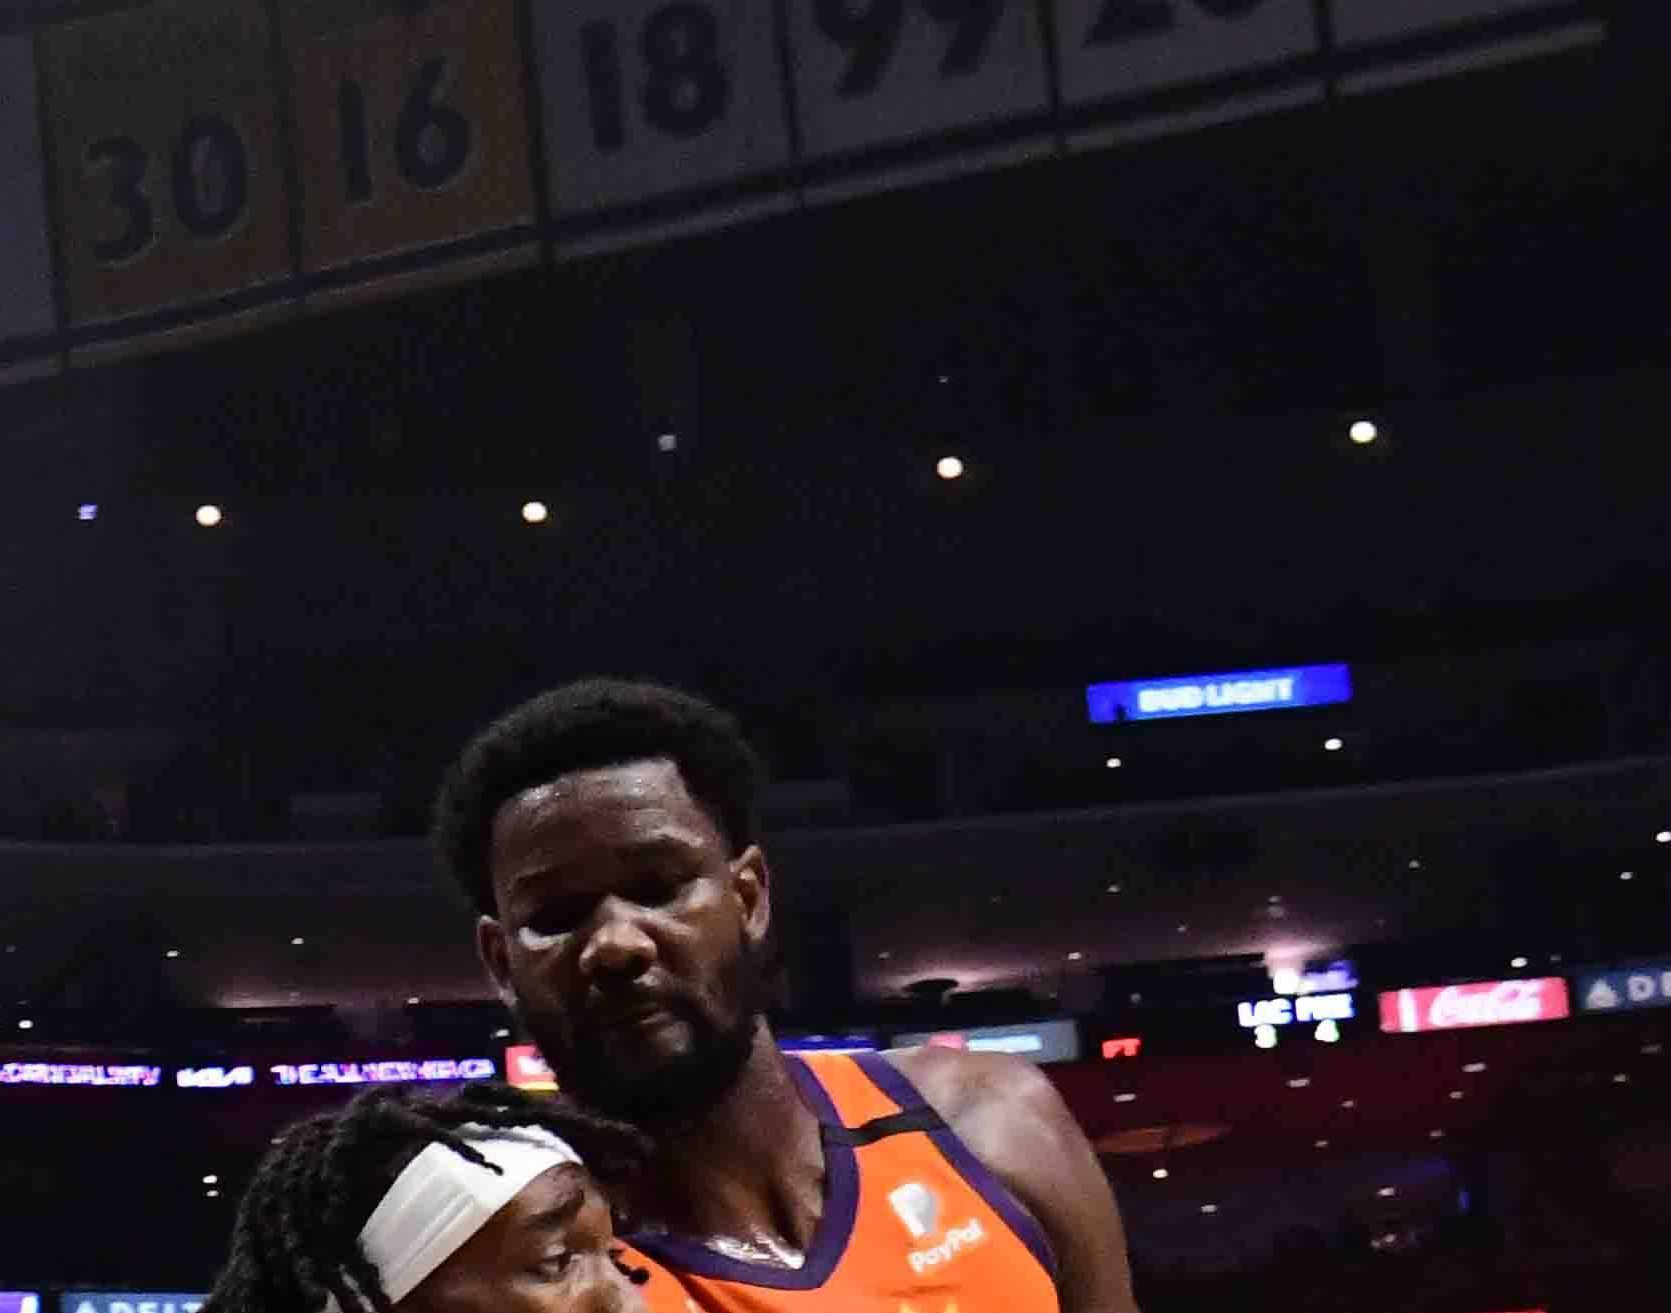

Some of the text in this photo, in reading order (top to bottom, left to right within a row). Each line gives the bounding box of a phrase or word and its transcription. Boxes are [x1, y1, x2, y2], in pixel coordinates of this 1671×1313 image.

[339, 56, 470, 197] 16
[579, 3, 731, 154] 18
[83, 112, 249, 265] 30
[908, 1219, 987, 1274] PayPal
